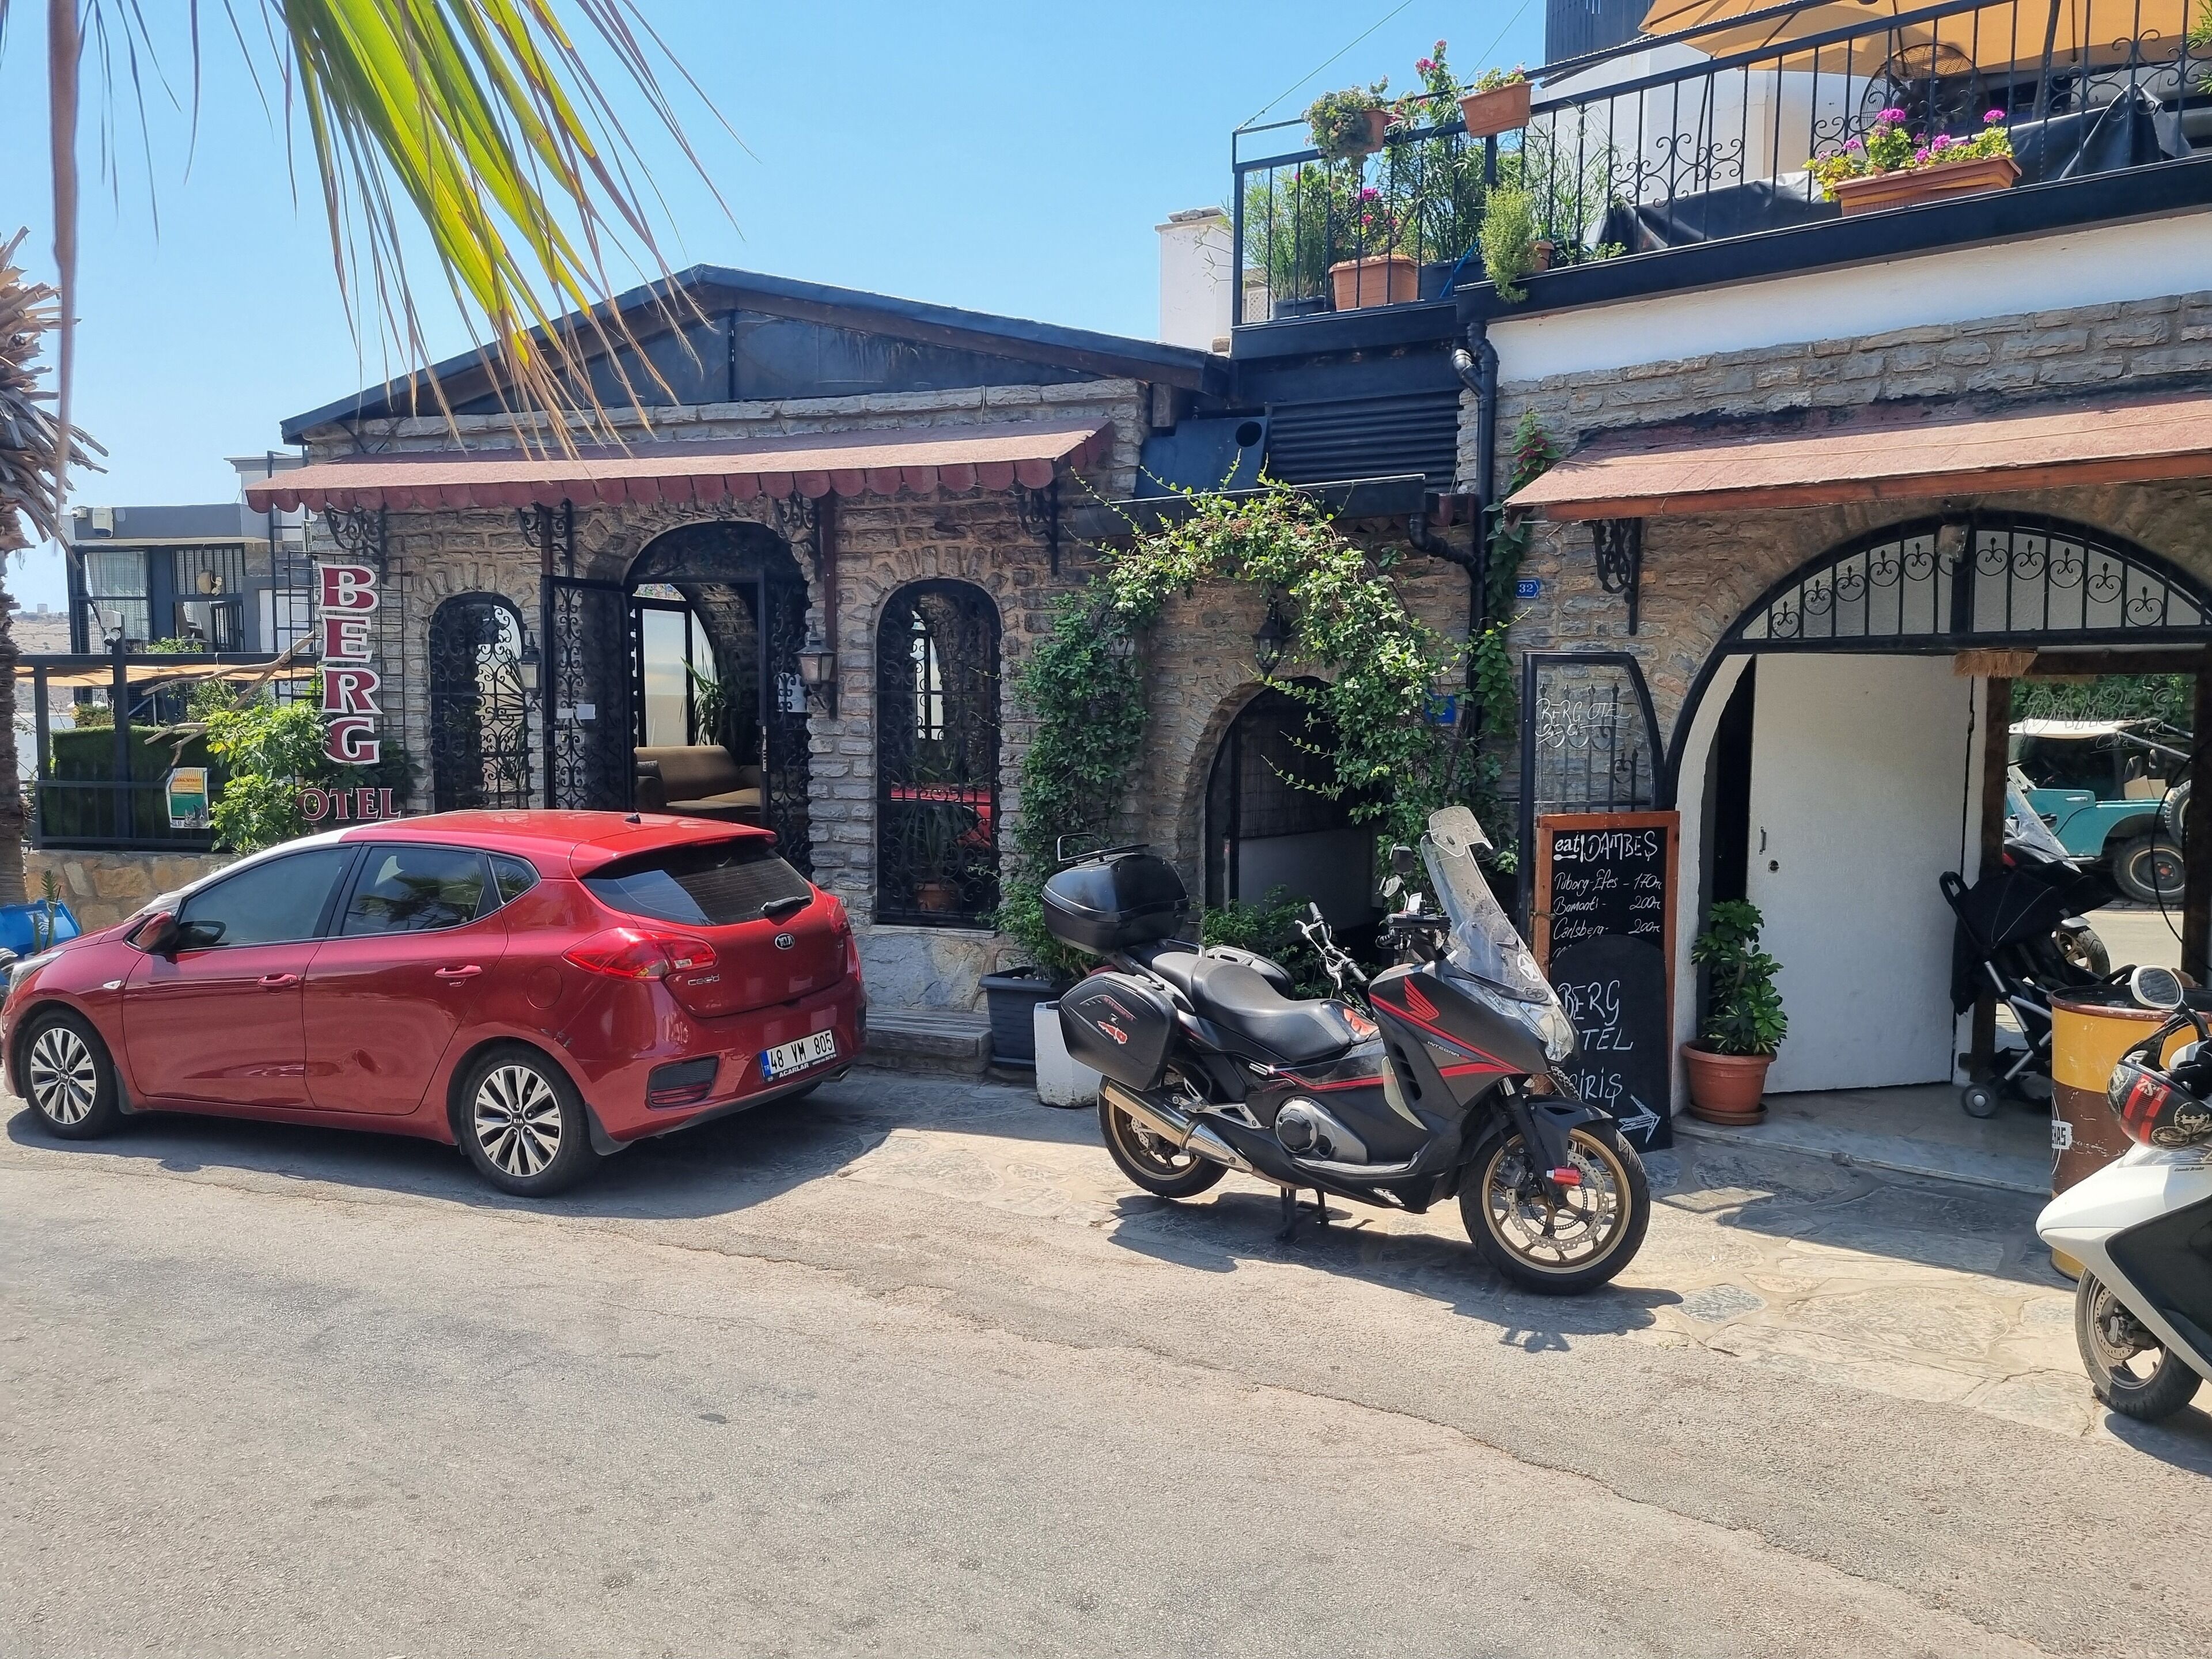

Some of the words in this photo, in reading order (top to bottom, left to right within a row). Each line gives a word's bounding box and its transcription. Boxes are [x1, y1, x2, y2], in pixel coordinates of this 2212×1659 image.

[1518, 584, 1533, 593] 32
[317, 563, 384, 765] BERG
[1535, 698, 1582, 736] BERG
[1588, 702, 1631, 720] OTEL
[295, 787, 402, 821] OTEL
[1555, 834, 1580, 853] eat
[778, 935, 793, 947] KIA
[1557, 979, 1620, 1027] BERG
[770, 1049, 784, 1070] 48
[790, 1041, 806, 1063] VM
[813, 1032, 833, 1055] 805
[1427, 1040, 1461, 1058] INTEGRA
[1576, 1027, 1634, 1051] TEL
[779, 1062, 809, 1078] ACARLAR
